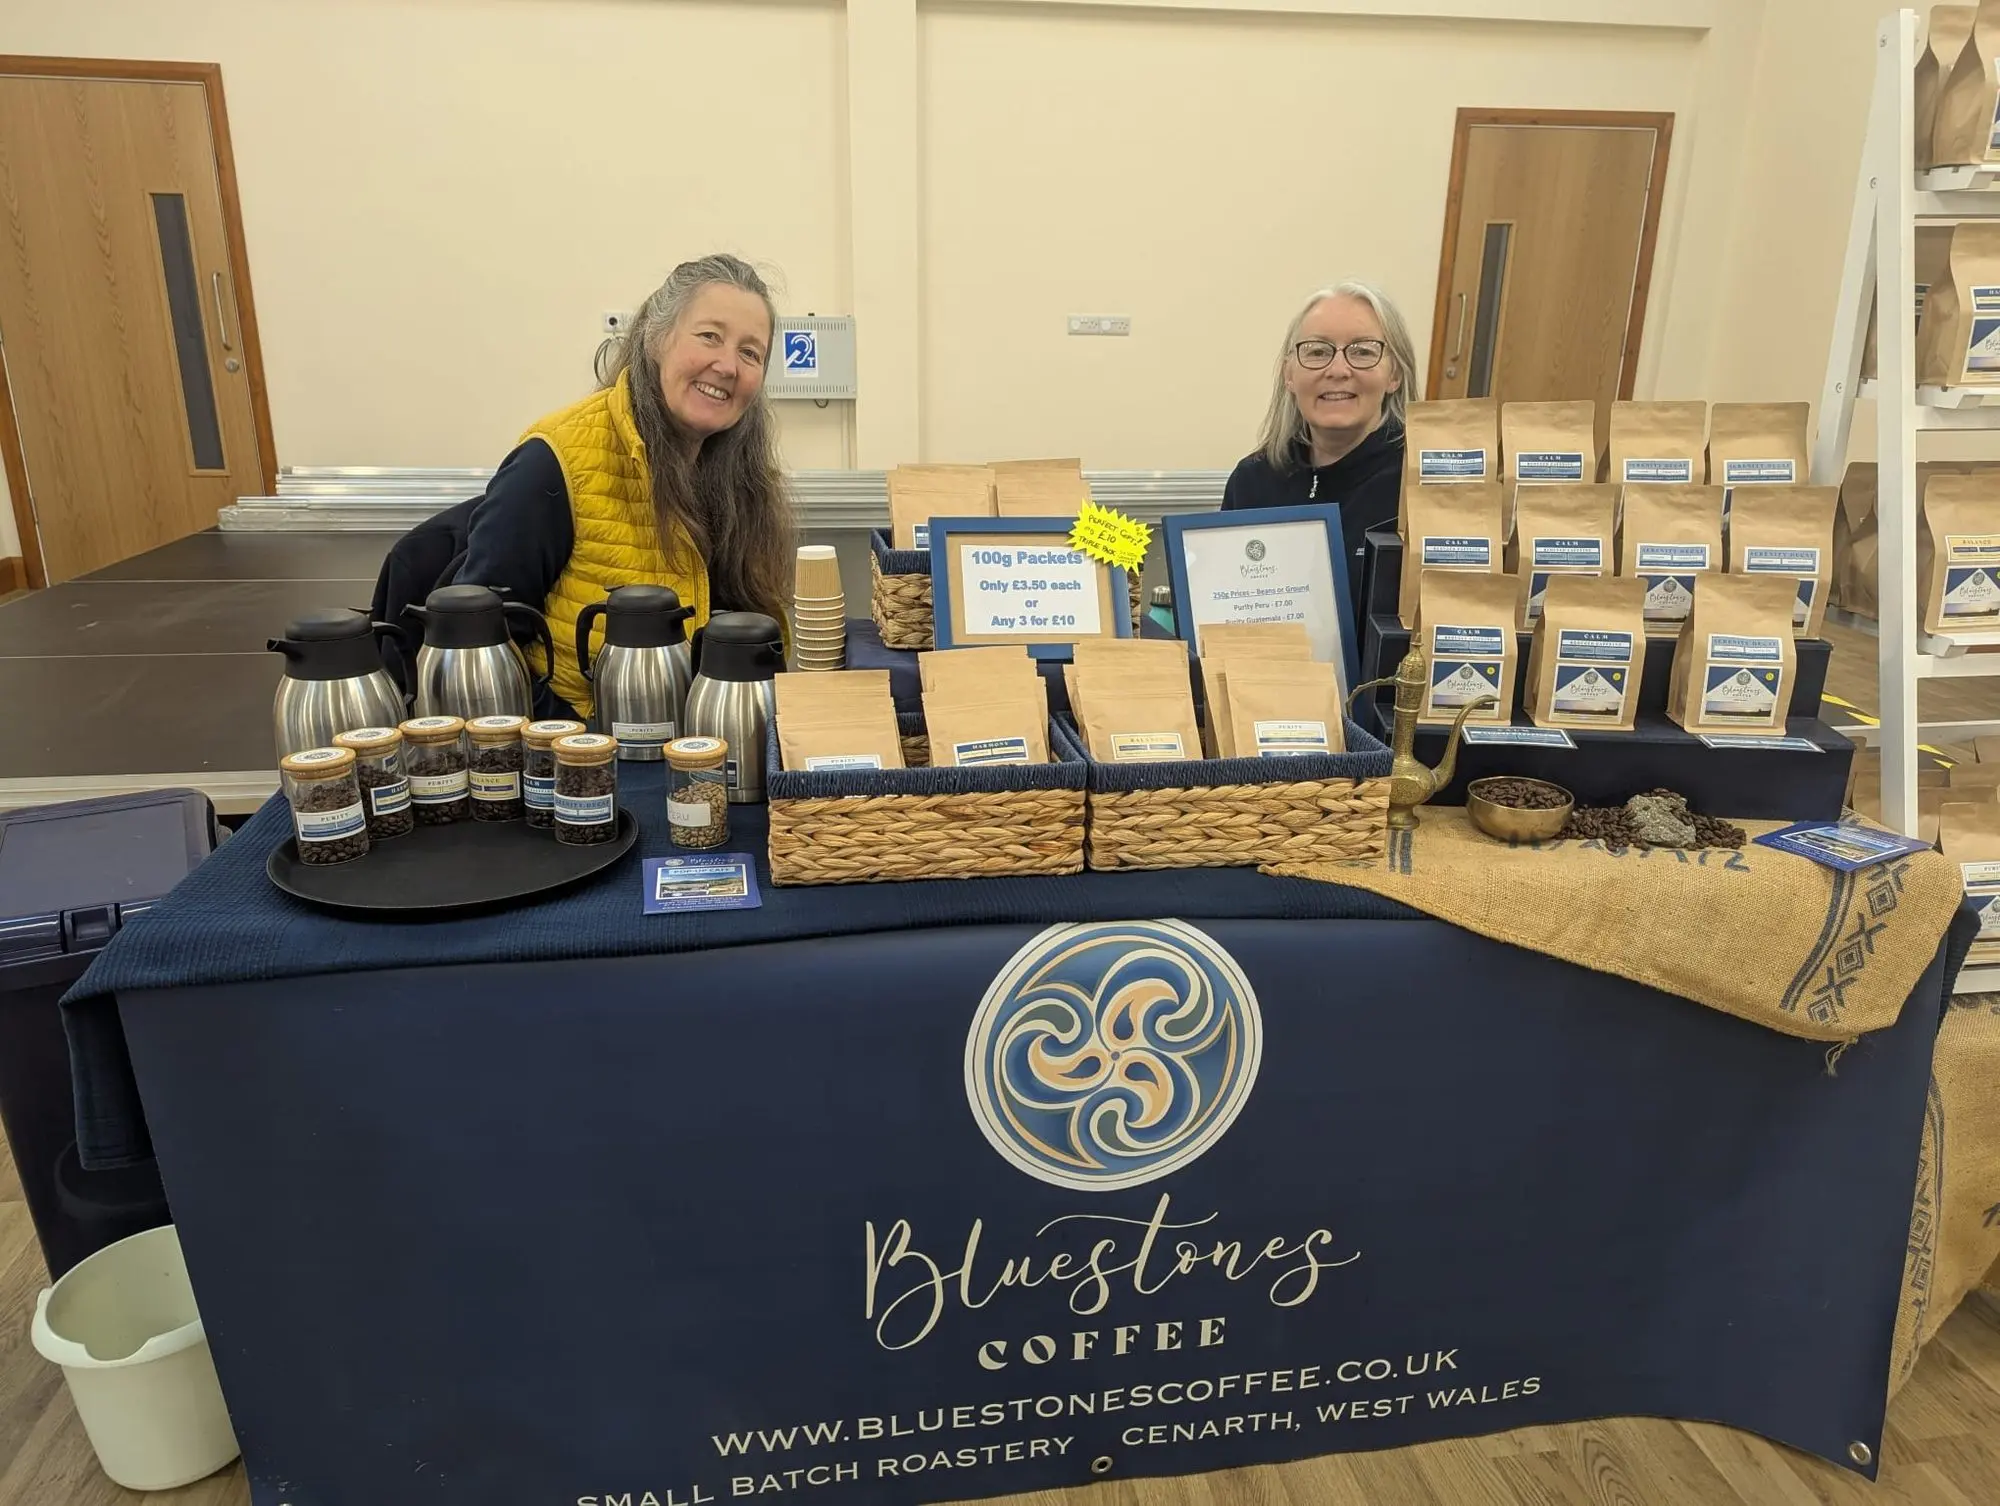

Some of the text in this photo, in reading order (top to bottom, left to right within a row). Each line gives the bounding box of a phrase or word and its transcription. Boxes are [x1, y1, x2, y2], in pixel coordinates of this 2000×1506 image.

[1079, 536, 1101, 550] TRIPLE
[1098, 530, 1116, 544] £10
[972, 551, 1082, 568] 100g Packets
[980, 580, 1081, 593] Only £3.50 each
[1213, 592, 1230, 600] 250g
[1286, 584, 1310, 592] Ground
[1025, 600, 1038, 608] or
[1234, 604, 1254, 612] Purity
[1255, 602, 1270, 610] Peru
[1275, 600, 1292, 608] £7.00
[991, 616, 1075, 628] Any 3 for £10
[1246, 615, 1281, 624] Guatemala
[1286, 612, 1304, 620] £7.00
[972, 740, 1009, 750] HARMONY
[320, 813, 349, 822] PURITY
[866, 1193, 1360, 1350] Bluestones
[978, 1317, 1226, 1370] COFFEE
[712, 1348, 1460, 1457] WWW.BLUESTONESCOFFEE.CO.UK
[576, 1376, 1541, 1506] SMALL BATCH ROASTERY CENARTH, WEST WALES
